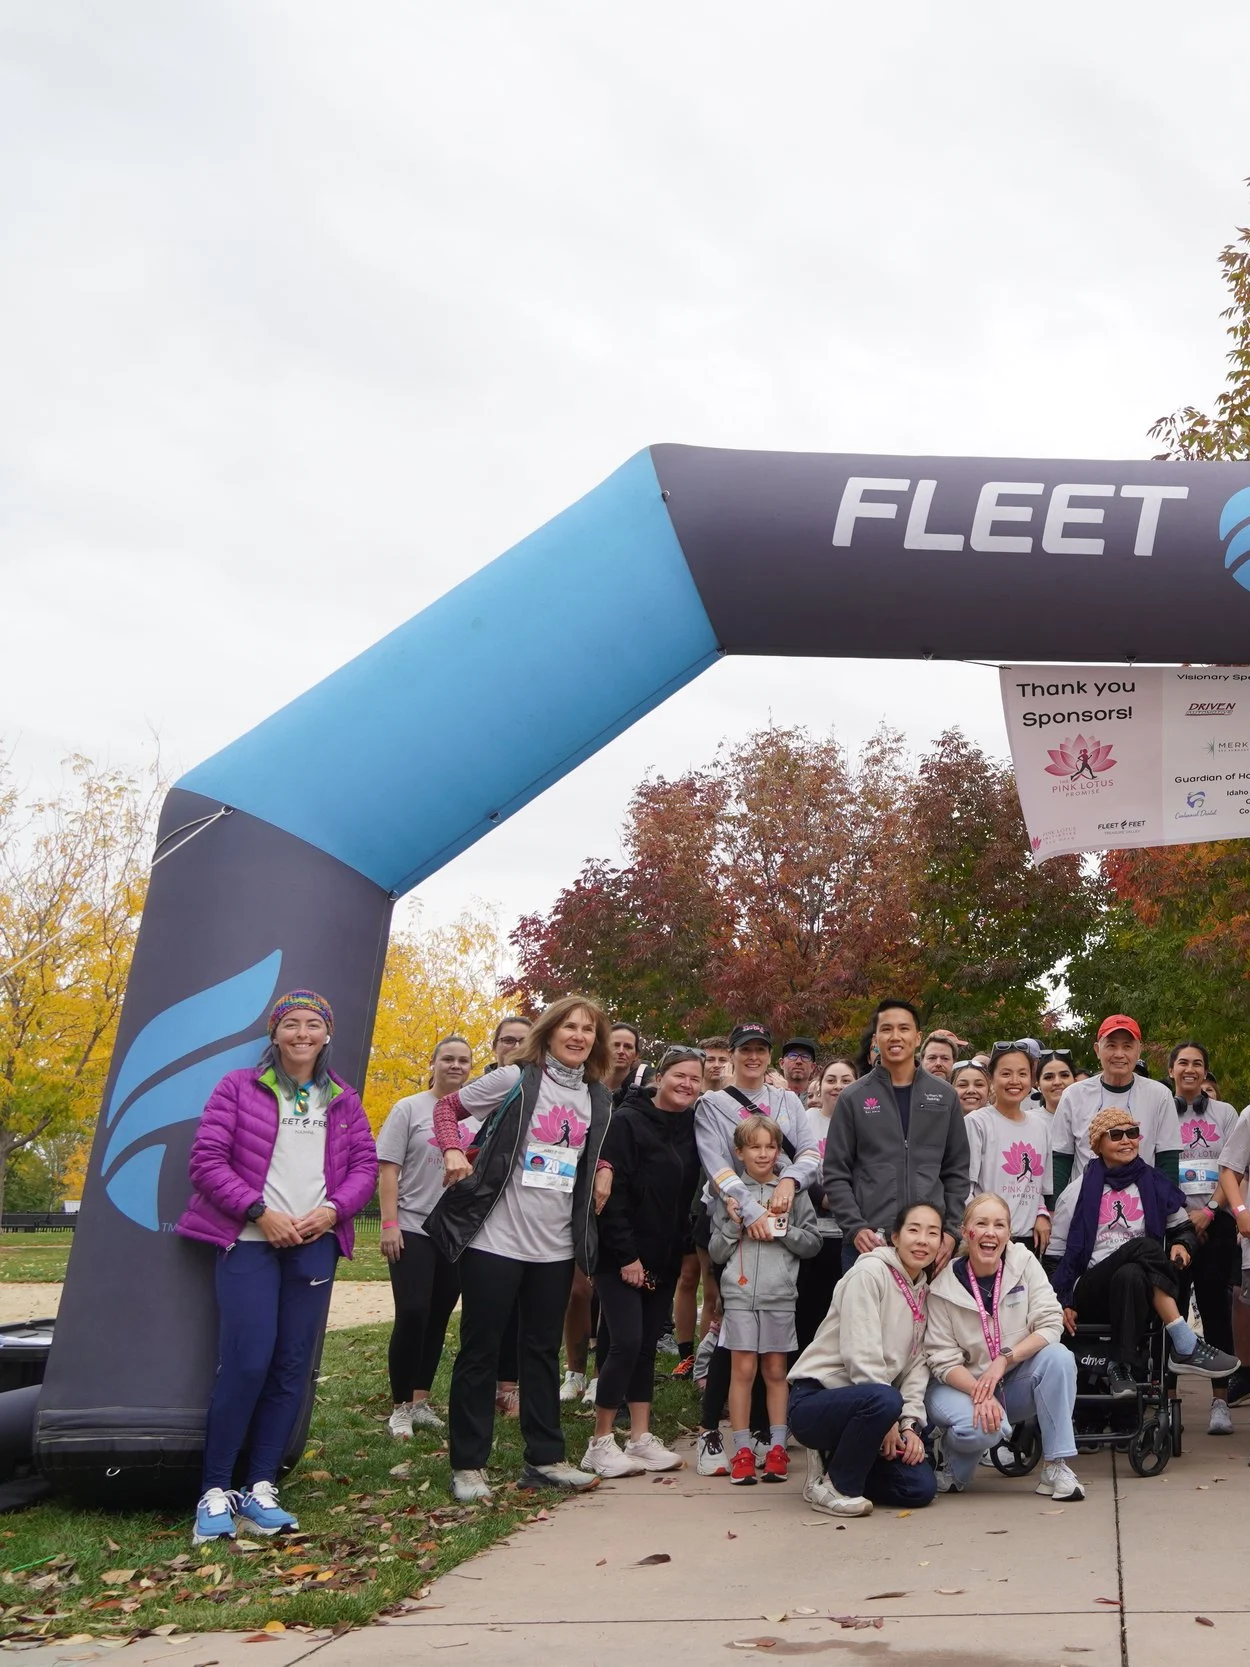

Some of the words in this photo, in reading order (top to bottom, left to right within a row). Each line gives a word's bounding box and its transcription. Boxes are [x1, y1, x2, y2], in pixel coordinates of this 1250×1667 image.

[832, 476, 1189, 557] FLEET
[1016, 681, 1087, 698] Thank
[1094, 682, 1135, 696] you
[1188, 702, 1236, 711] DRIVEN
[1022, 706, 1132, 728] Sponsors!
[1174, 774, 1223, 784] Guardian
[1225, 773, 1236, 781] of
[1052, 783, 1077, 793] PINK
[1080, 779, 1114, 790] LOTUS
[1065, 788, 1100, 797] PROMISE
[1098, 822, 1119, 830] FLEET
[1128, 820, 1146, 828] FEET
[544, 1159, 560, 1174] 20
[1197, 1170, 1206, 1180] 19
[1002, 1185, 1021, 1193] PINK
[1081, 1354, 1106, 1366] drive
